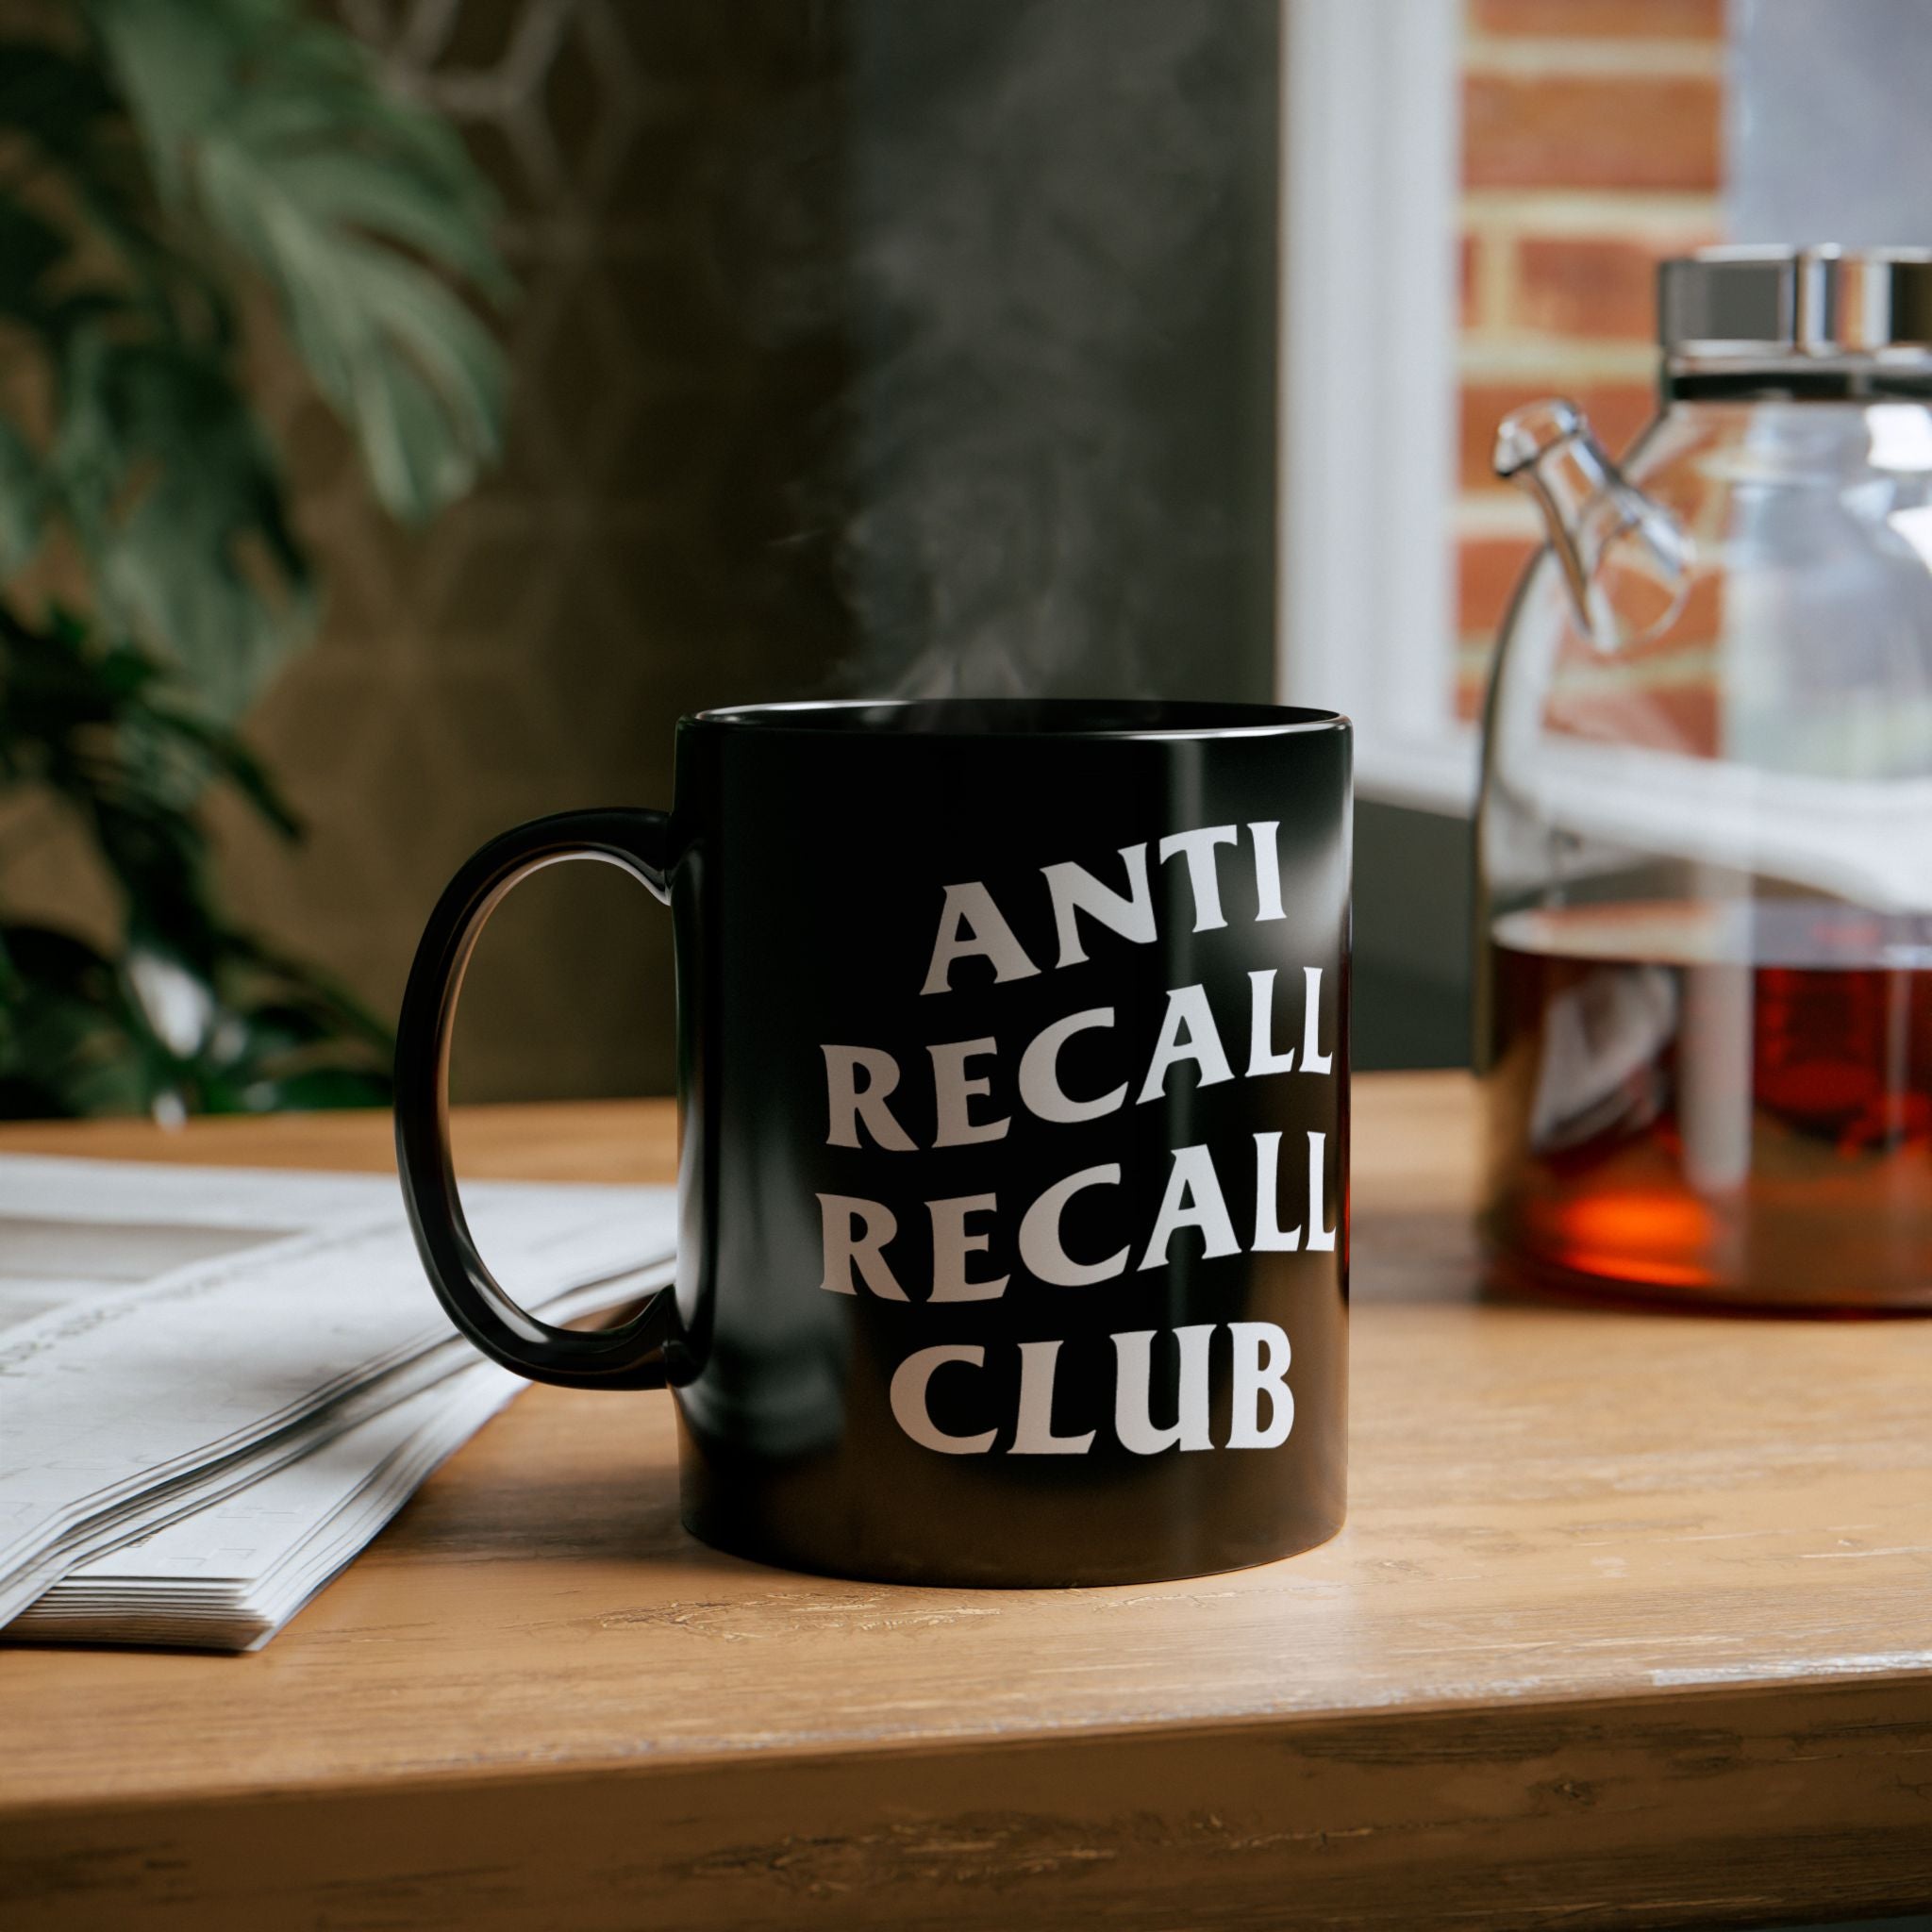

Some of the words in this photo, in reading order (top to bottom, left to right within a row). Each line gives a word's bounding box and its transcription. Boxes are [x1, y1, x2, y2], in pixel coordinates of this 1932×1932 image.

[920, 821, 1288, 996] ANTI
[820, 966, 1333, 1151] RECALL
[815, 1131, 1336, 1303] RECALL
[890, 1322, 1295, 1456] CLUB
